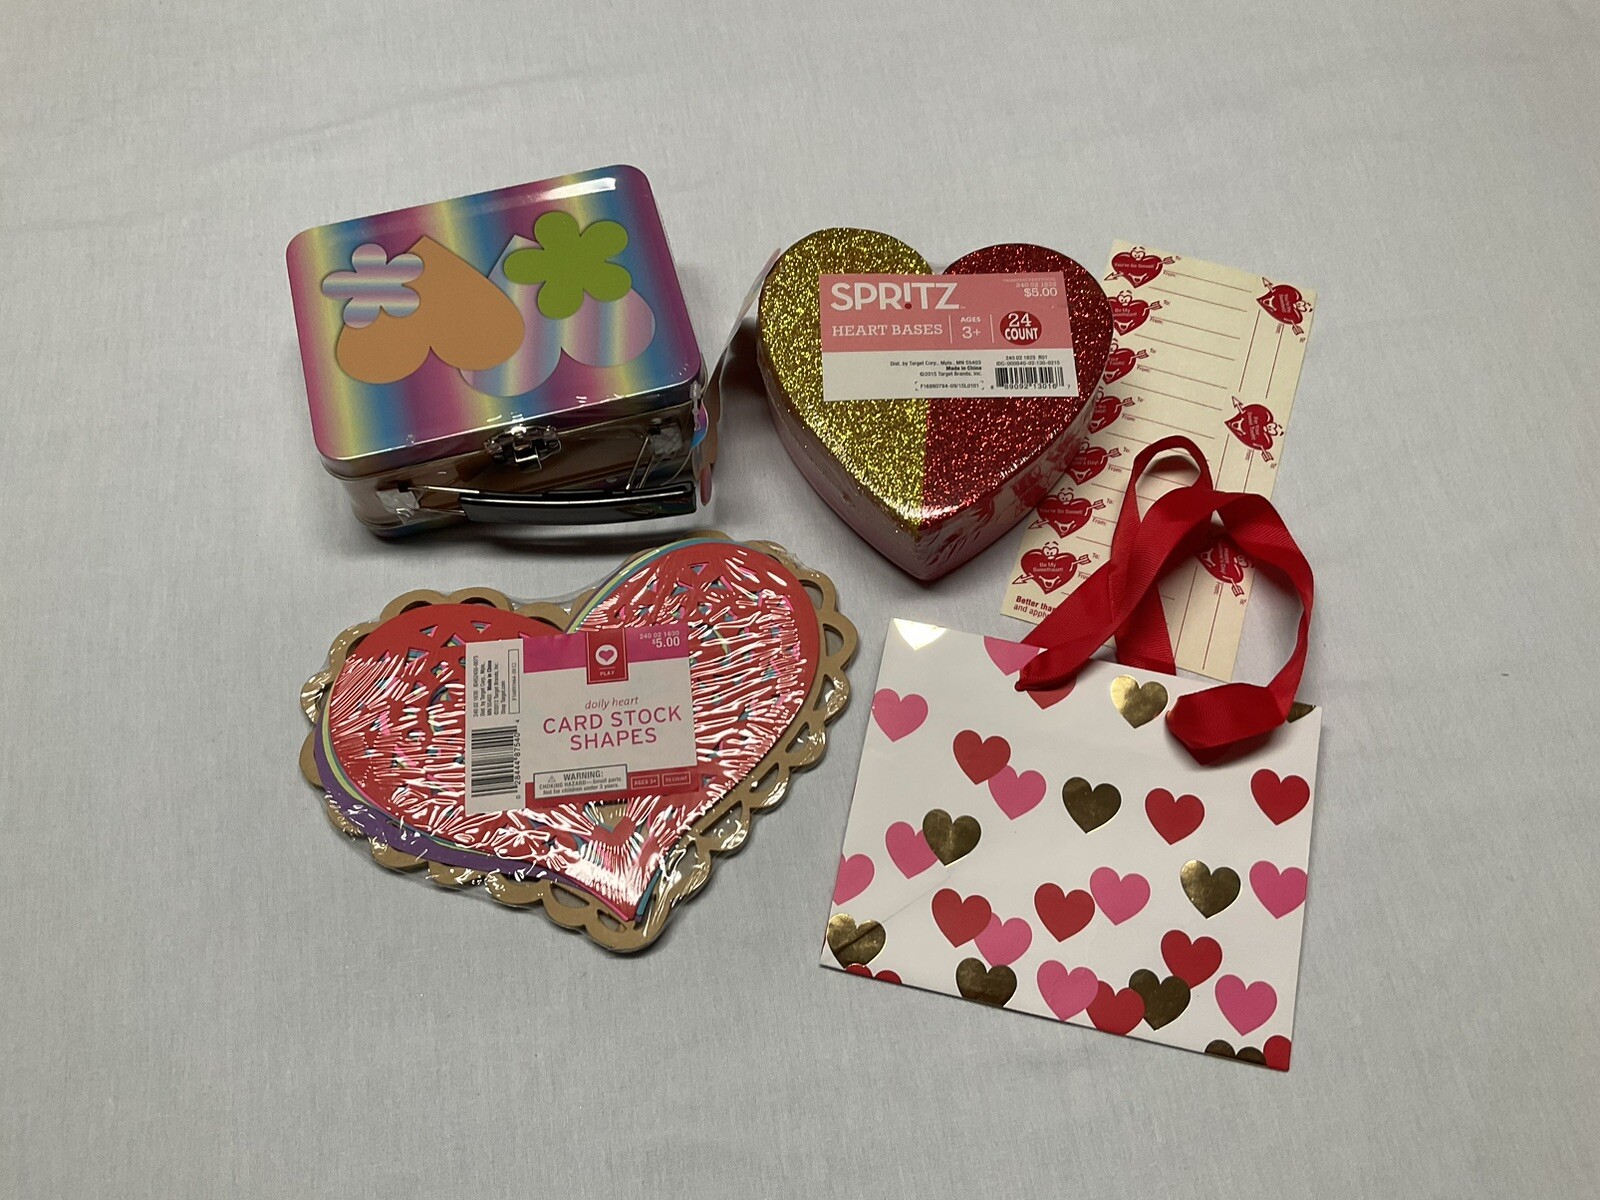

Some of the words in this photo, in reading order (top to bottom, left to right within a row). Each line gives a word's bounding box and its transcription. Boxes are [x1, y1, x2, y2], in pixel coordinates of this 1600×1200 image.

[1023, 287, 1058, 298] $5.00
[1008, 313, 1032, 327] 24
[832, 325, 887, 337] HEART
[892, 324, 943, 336] BASES
[962, 326, 981, 339] 3+
[1005, 327, 1038, 340] COUNT
[1092, 552, 1100, 560] To:
[1013, 603, 1028, 613] and
[1015, 595, 1039, 608] Better
[652, 636, 680, 648] $5.00
[585, 700, 610, 711] doily
[612, 696, 639, 707] heart
[543, 713, 603, 734] CARD
[611, 705, 682, 728] STOCK
[513, 732, 521, 757] 87540
[570, 727, 657, 751] SHAPES
[563, 770, 604, 781] WARNING:
[539, 781, 563, 790] CHOKING
[561, 785, 583, 793] children
